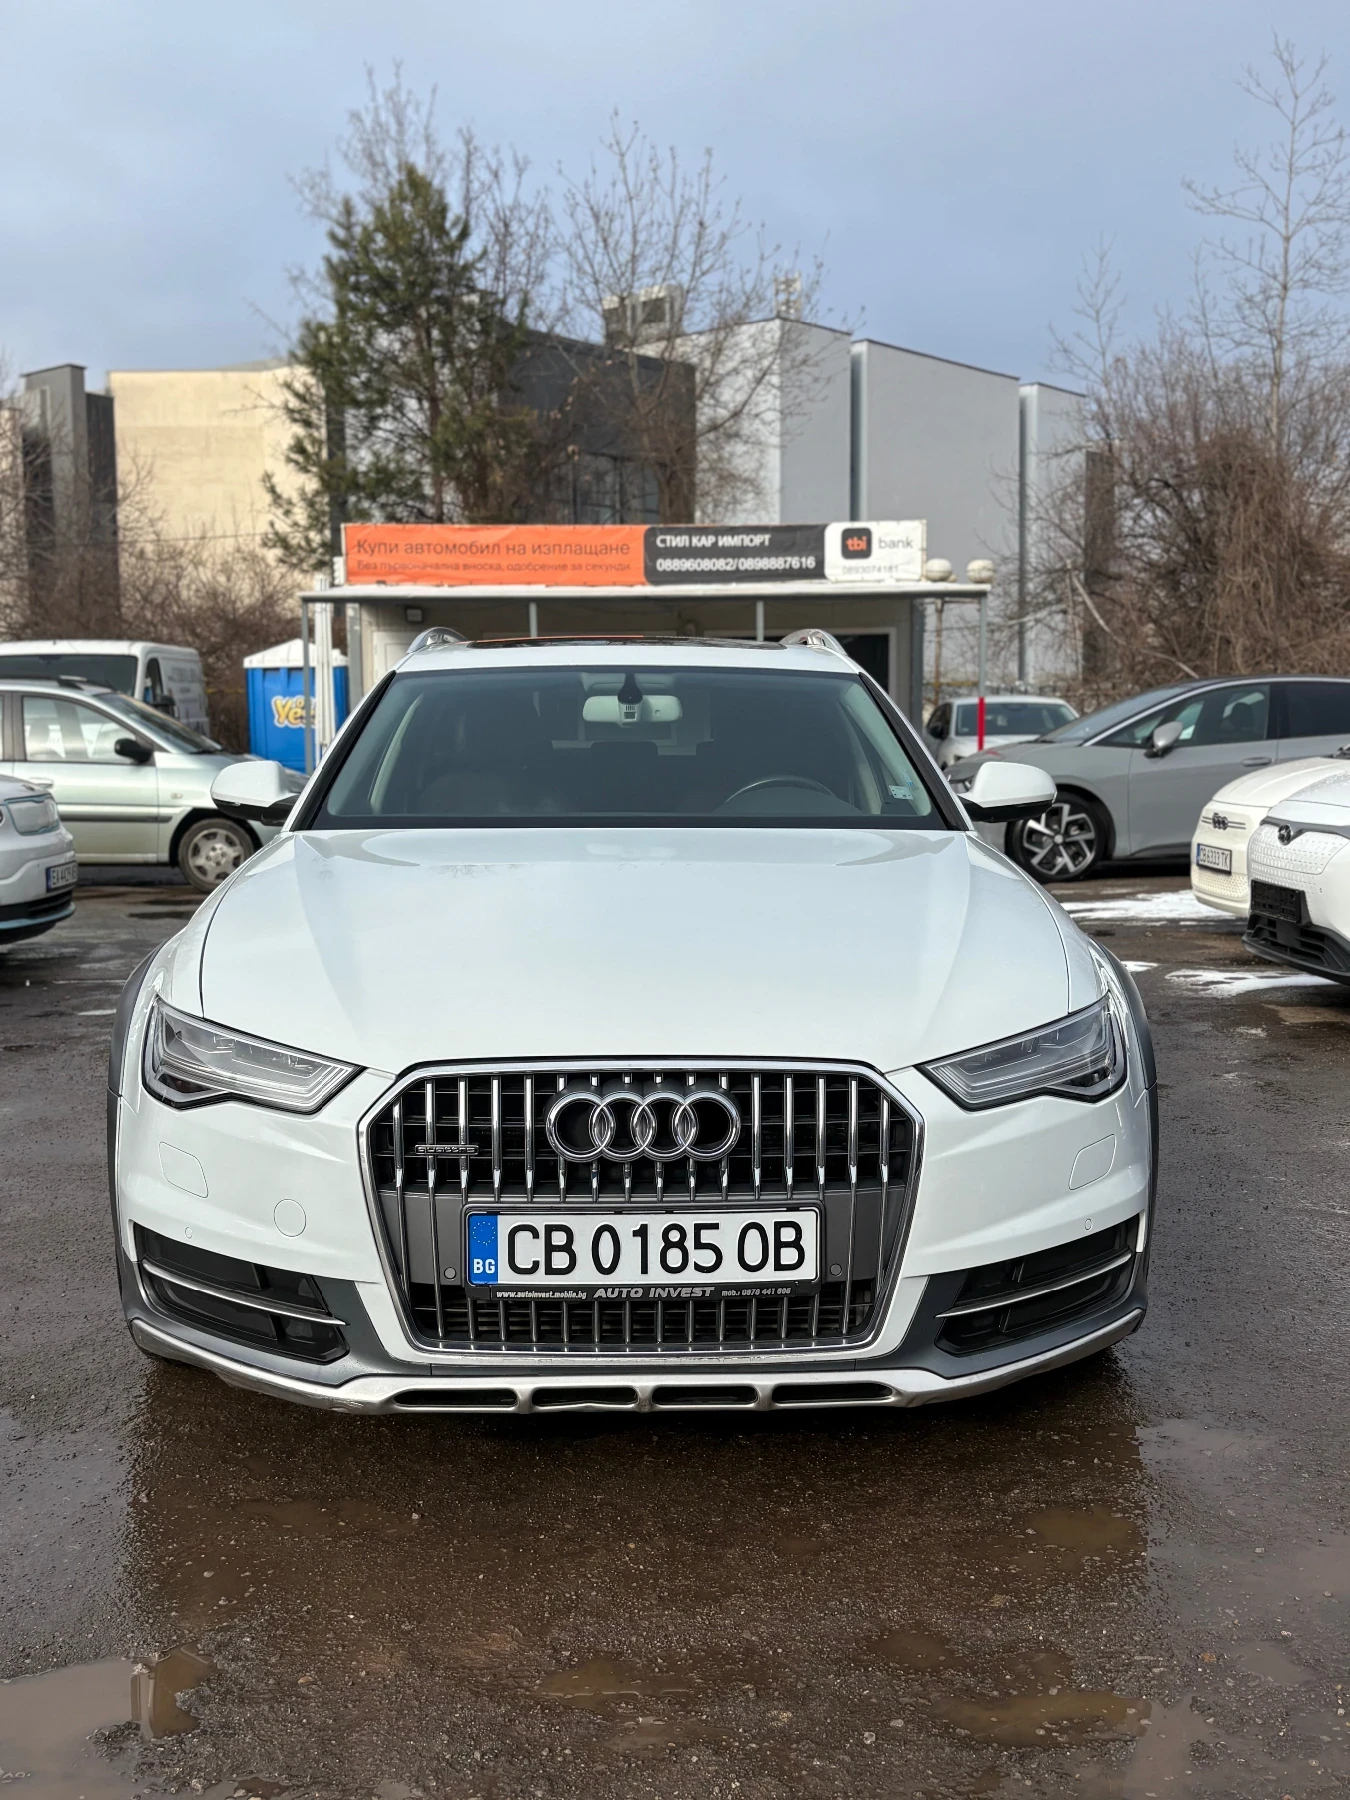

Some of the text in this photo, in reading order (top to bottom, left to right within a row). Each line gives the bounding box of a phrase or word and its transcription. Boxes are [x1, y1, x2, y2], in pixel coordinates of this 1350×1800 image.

[357, 539, 630, 557] Купи автомобил на изплащане
[656, 534, 771, 547] СТИЛ КАР ИМПОРТ
[846, 536, 913, 551] tbi bank
[473, 1258, 495, 1274] BG
[507, 1223, 577, 1275] CB
[591, 1222, 723, 1275] 0185
[593, 1287, 643, 1298] AUTO
[649, 1286, 715, 1298] INVEST
